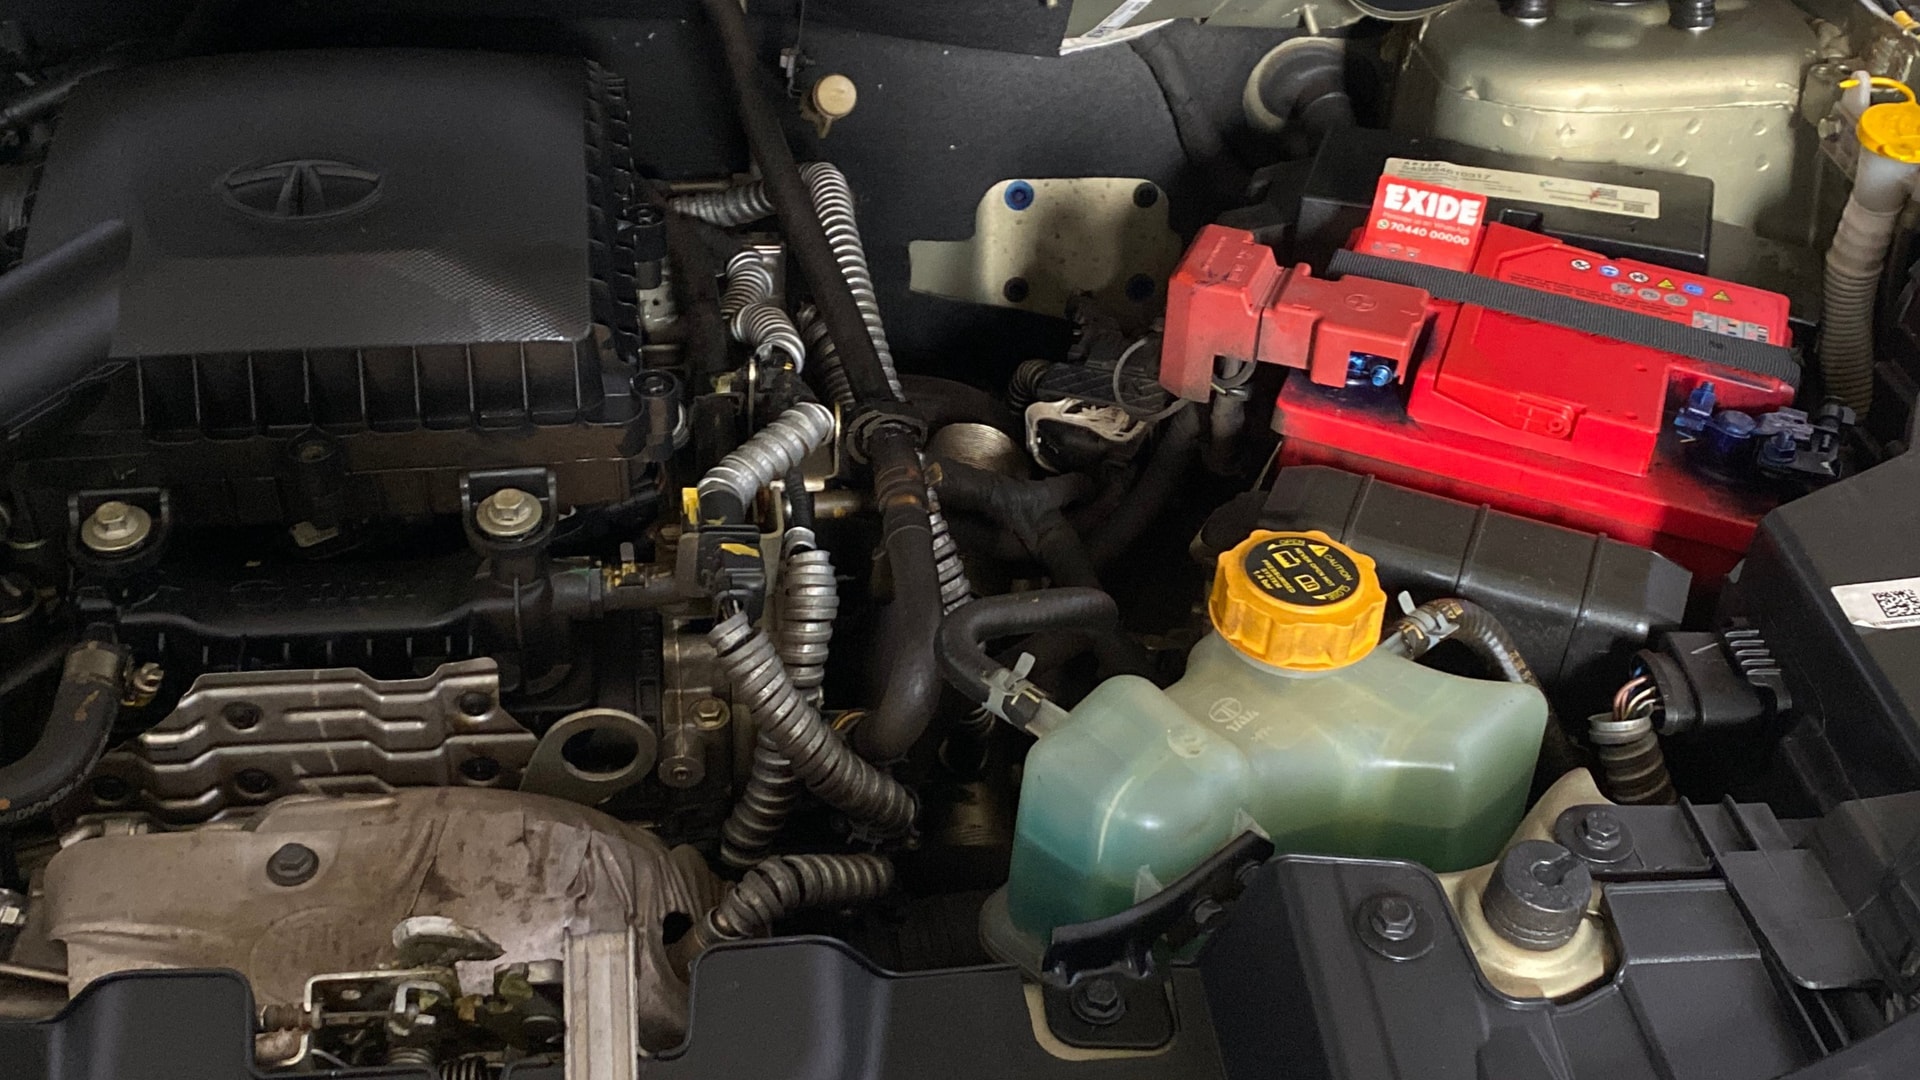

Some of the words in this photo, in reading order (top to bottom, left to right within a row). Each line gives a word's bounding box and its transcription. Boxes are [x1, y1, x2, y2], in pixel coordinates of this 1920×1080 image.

[1383, 183, 1482, 227] EXIDE
[1390, 221, 1428, 237] 70440
[1429, 230, 1470, 246] 00000
[1323, 554, 1354, 581] CAUTION
